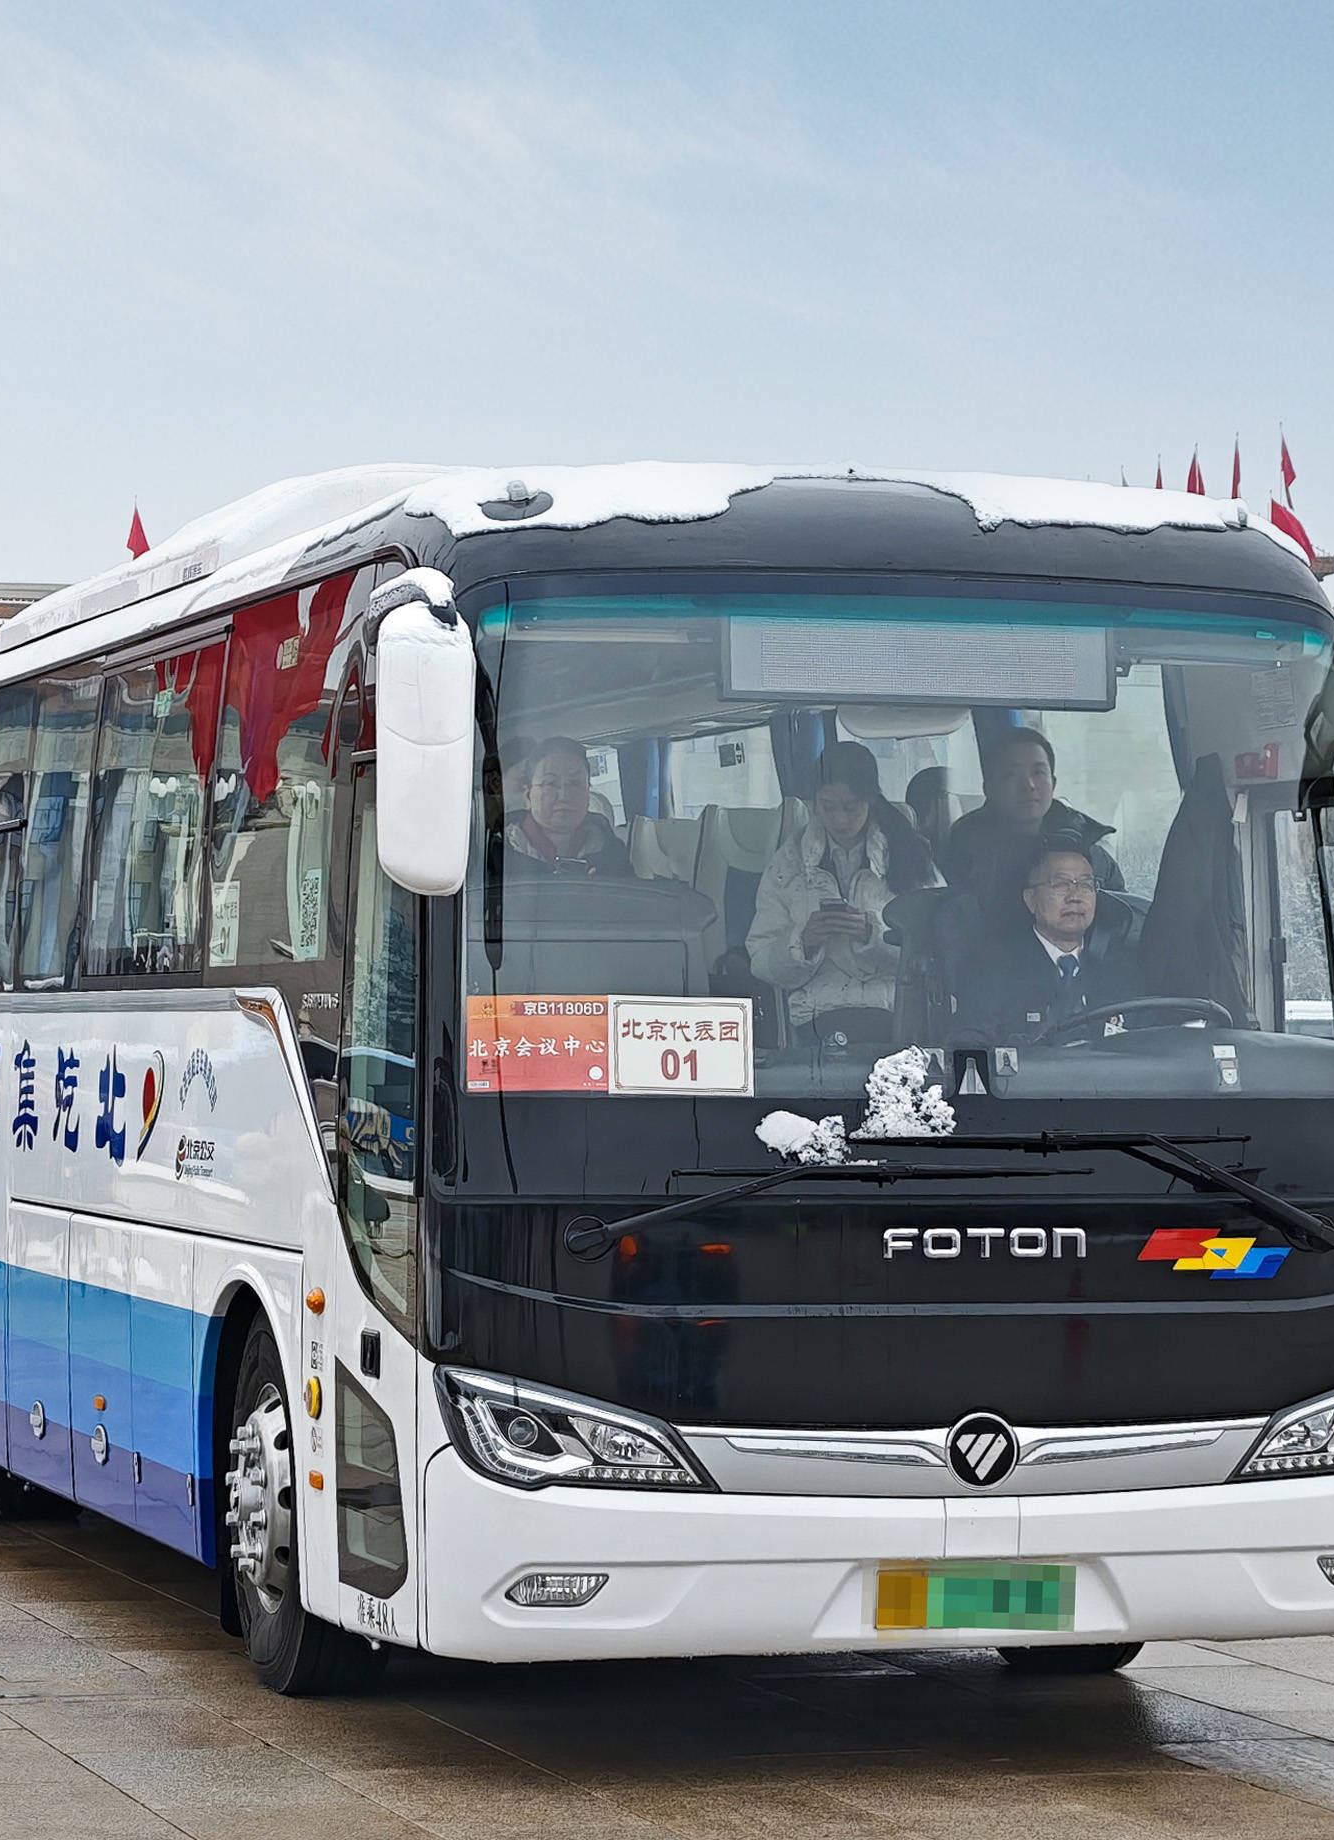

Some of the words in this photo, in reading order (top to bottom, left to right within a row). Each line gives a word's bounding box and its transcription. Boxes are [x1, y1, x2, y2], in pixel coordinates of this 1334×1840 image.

[523, 1002, 604, 1016] 京B11806D
[621, 1018, 739, 1042] 北京代表团
[468, 1035, 606, 1058] 北京会议中心
[660, 1048, 698, 1081] 01
[882, 1227, 1087, 1259] FOTON
